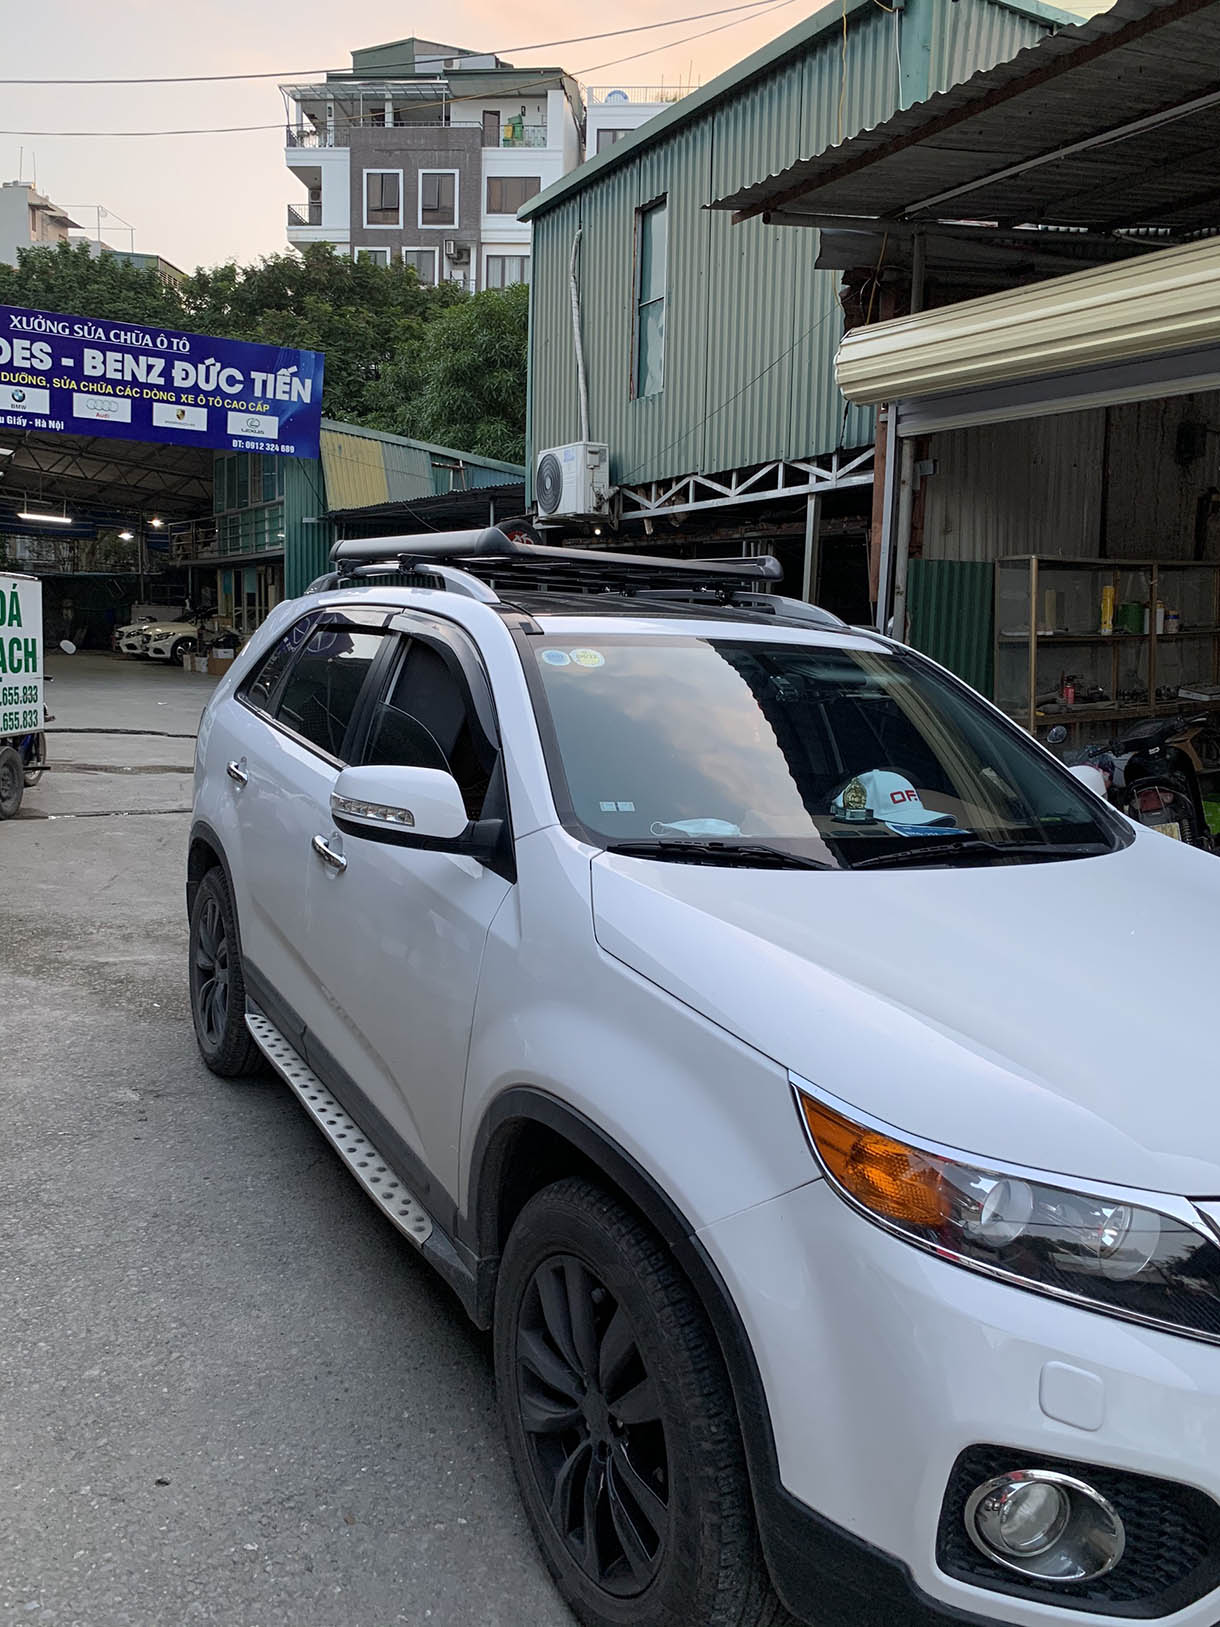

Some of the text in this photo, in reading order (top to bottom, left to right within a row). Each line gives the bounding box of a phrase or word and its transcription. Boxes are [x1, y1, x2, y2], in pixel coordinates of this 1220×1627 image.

[9, 314, 190, 353] XƯỞNG SỬA CHỮA Ô TÔ
[53, 375, 77, 391] SỬA
[80, 380, 114, 396] CHỮA
[116, 384, 141, 398] CÁC
[143, 387, 176, 402] DÒNG
[180, 394, 195, 404] XE
[197, 393, 206, 405] Ô
[207, 395, 222, 408] TÔ
[224, 399, 247, 411] CAO
[61, 357, 75, 367] -
[83, 347, 165, 386] BENZ
[171, 357, 245, 395] ĐỨC
[250, 365, 312, 404] TIẾN
[6, 415, 28, 427] Giấy
[34, 418, 47, 428] Hà
[48, 420, 64, 431] Nội
[245, 441, 265, 451] 0912
[265, 443, 280, 452] 324
